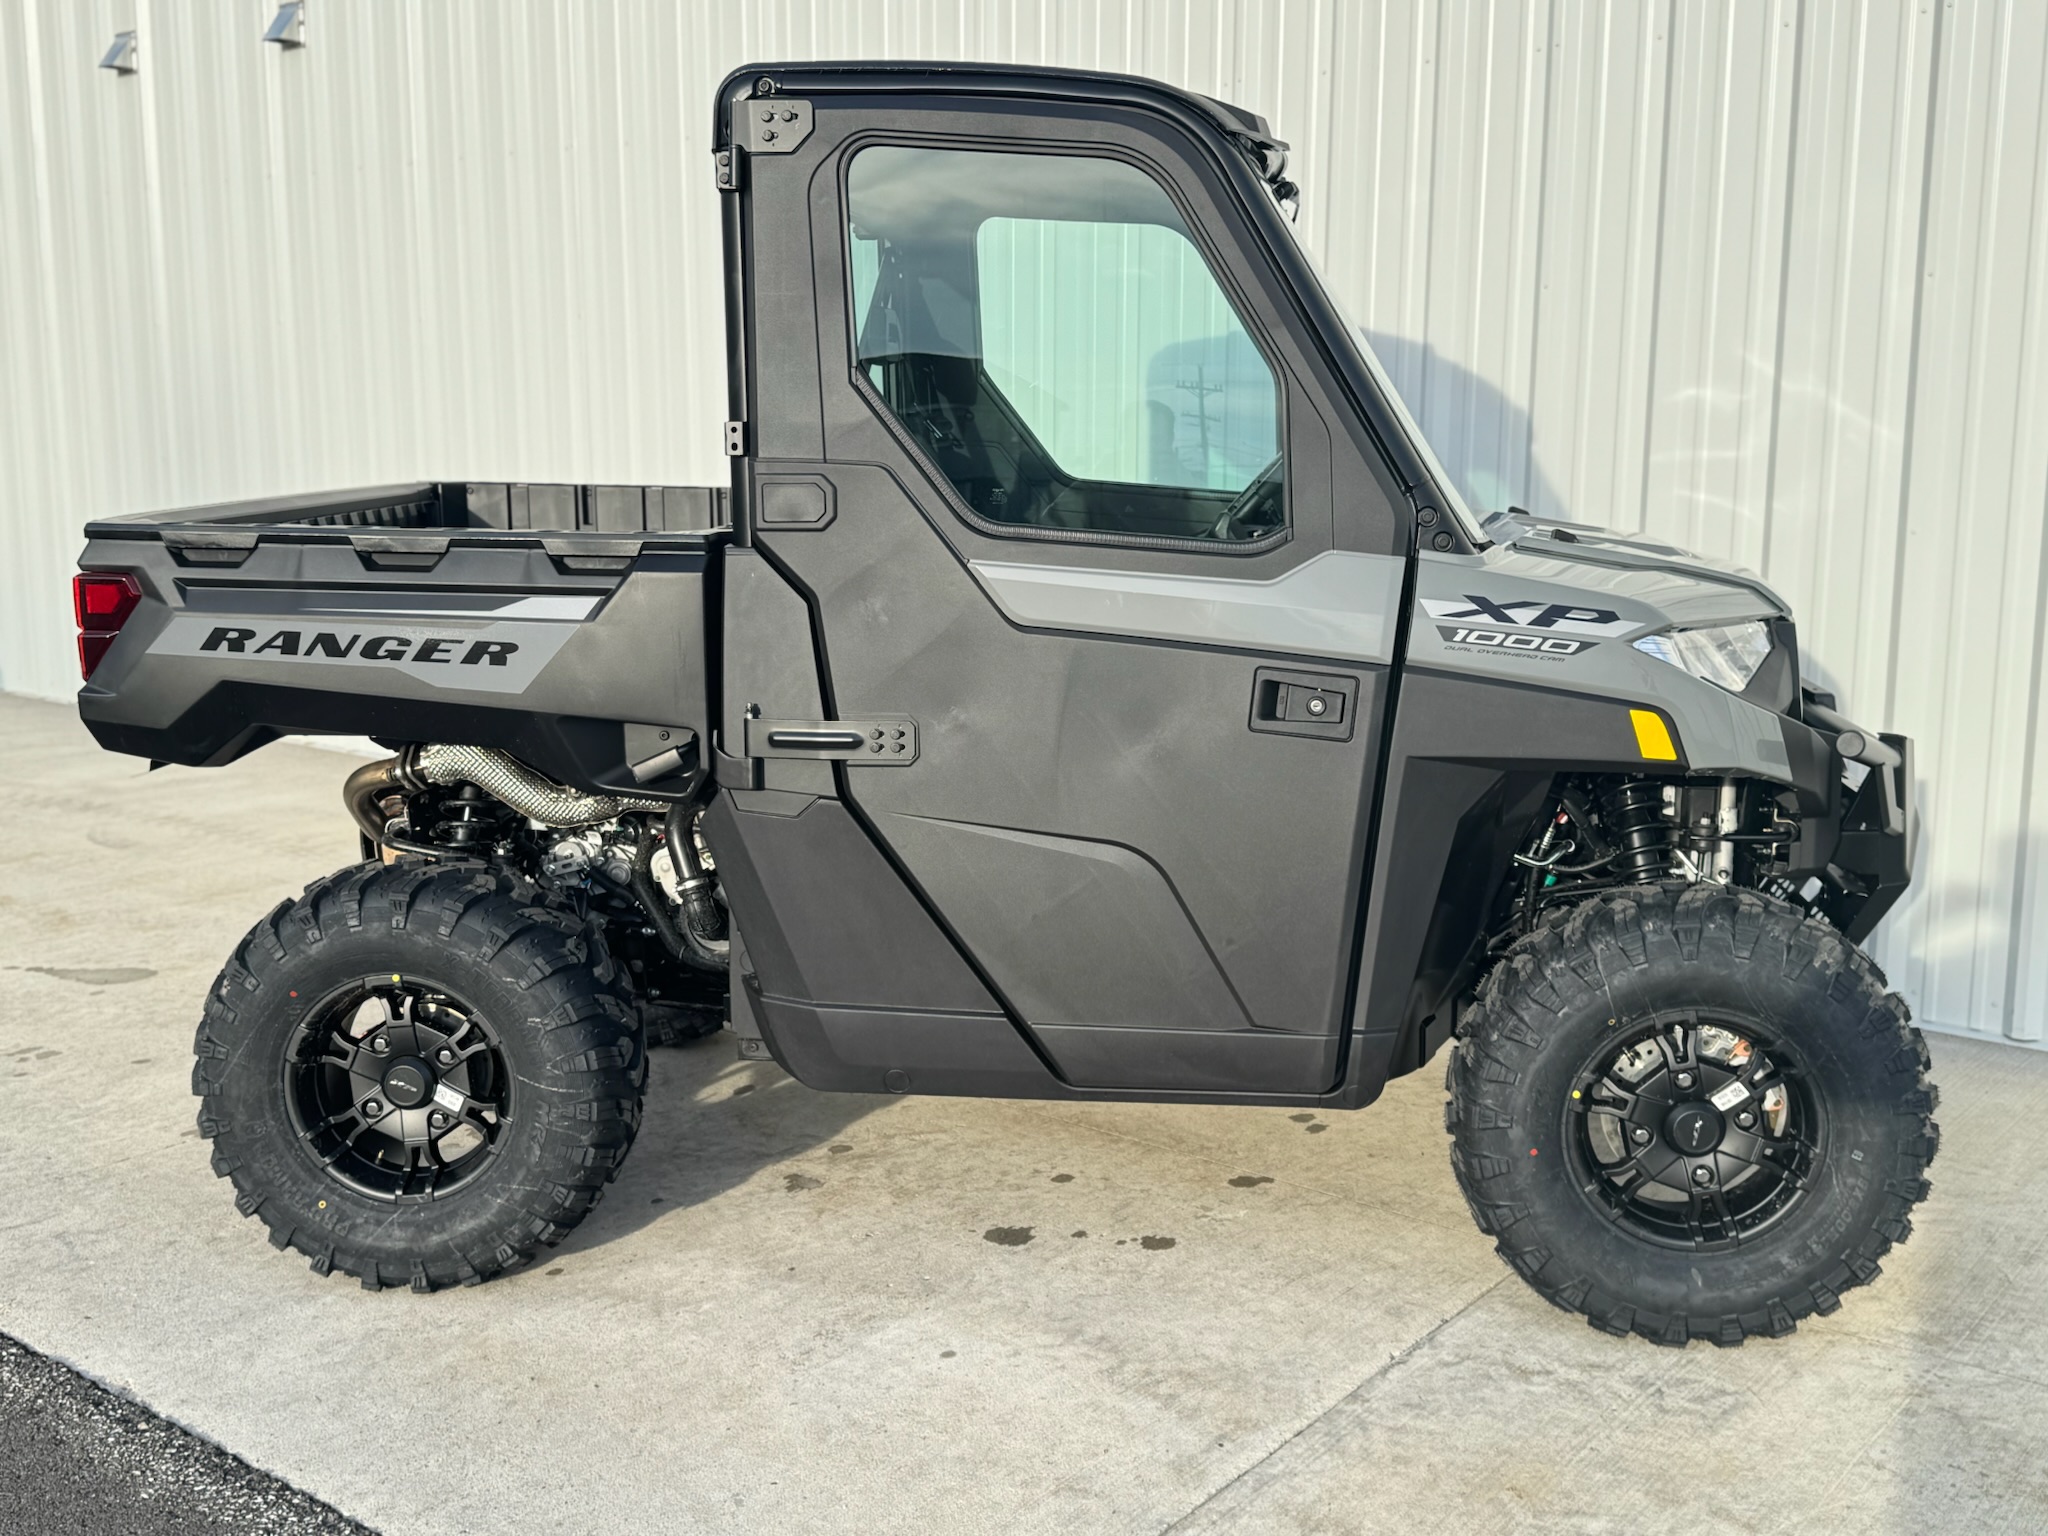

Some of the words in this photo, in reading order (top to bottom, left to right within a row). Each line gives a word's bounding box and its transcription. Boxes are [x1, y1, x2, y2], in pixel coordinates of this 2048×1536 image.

[1438, 595, 1621, 628] XP
[199, 627, 520, 666] RANGER
[1443, 645, 1474, 654] DUAL
[1477, 648, 1538, 660] OVERHEAD
[1452, 628, 1581, 654] 1000
